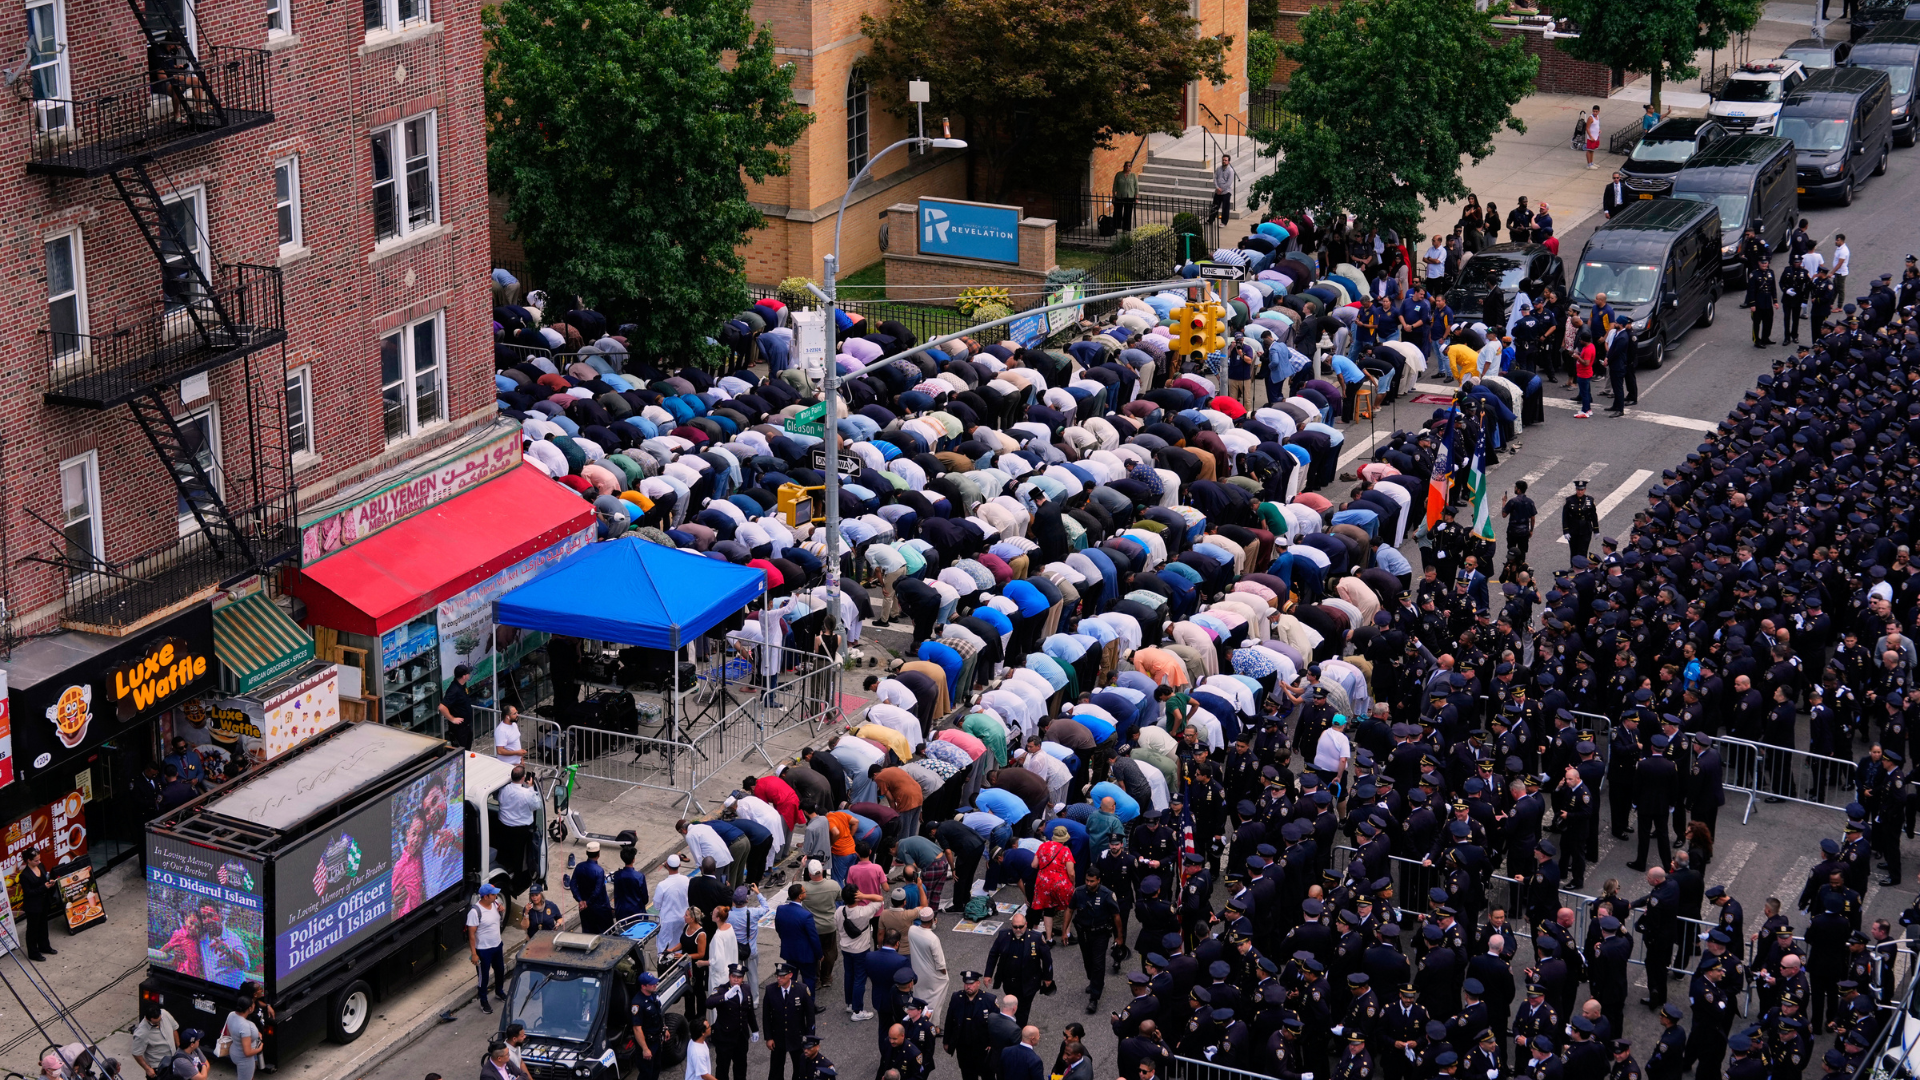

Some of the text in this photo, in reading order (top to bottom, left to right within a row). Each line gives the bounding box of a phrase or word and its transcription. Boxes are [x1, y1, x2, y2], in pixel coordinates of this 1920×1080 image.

[952, 226, 1013, 239] REVELATION
[801, 405, 822, 419] White Plains
[786, 420, 815, 434] Gleason
[442, 454, 489, 486] يمن
[838, 460, 854, 469] WAY
[458, 469, 488, 489] ماركت
[359, 496, 388, 525] ABU
[390, 474, 436, 509] YEMEN
[368, 495, 429, 532] MEAT MARKET
[479, 582, 496, 596] Meat
[496, 569, 518, 585] Market
[116, 644, 174, 700] Luxe
[248, 650, 307, 685] AFRICAN GROCERIES SPICES
[133, 655, 206, 710] Waffle
[212, 706, 243, 721] Luxe
[220, 719, 260, 738] Waffle
[36, 755, 49, 766] 1204
[0, 837, 50, 870] CHOCATE
[8, 832, 36, 855] DUBAI
[154, 846, 214, 870] In Loving Memory
[162, 861, 208, 878] of Our Brother
[153, 870, 257, 908] P.O. Didarul Islam
[289, 861, 387, 924] In Loving Memory of Our Brother
[289, 882, 386, 949] Police Officer
[289, 901, 386, 969] Didarul Islam
[602, 1051, 614, 1064] POLICE
